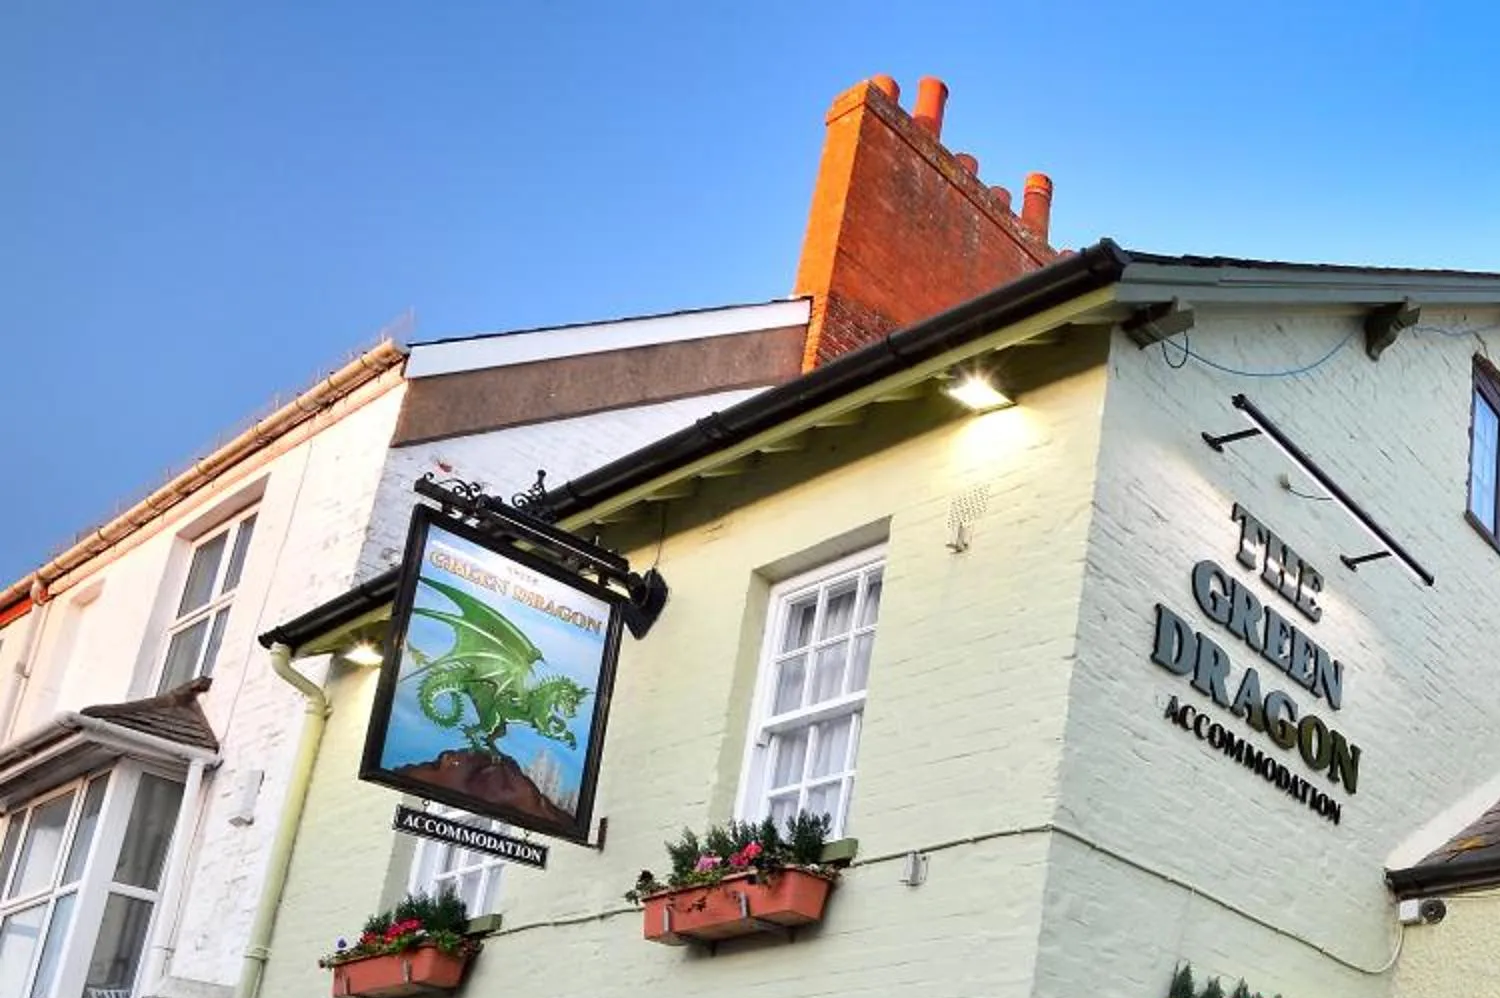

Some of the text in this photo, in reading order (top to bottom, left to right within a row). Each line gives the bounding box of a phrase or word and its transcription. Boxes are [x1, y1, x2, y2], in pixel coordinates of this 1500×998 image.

[512, 585, 602, 635] DRAGON
[1232, 502, 1324, 623] THE
[1192, 559, 1345, 711] GREEN
[1150, 603, 1362, 794] DRAGON
[1164, 695, 1343, 825] ACCOMMODATION
[403, 814, 542, 862] ACCOMMODATION
